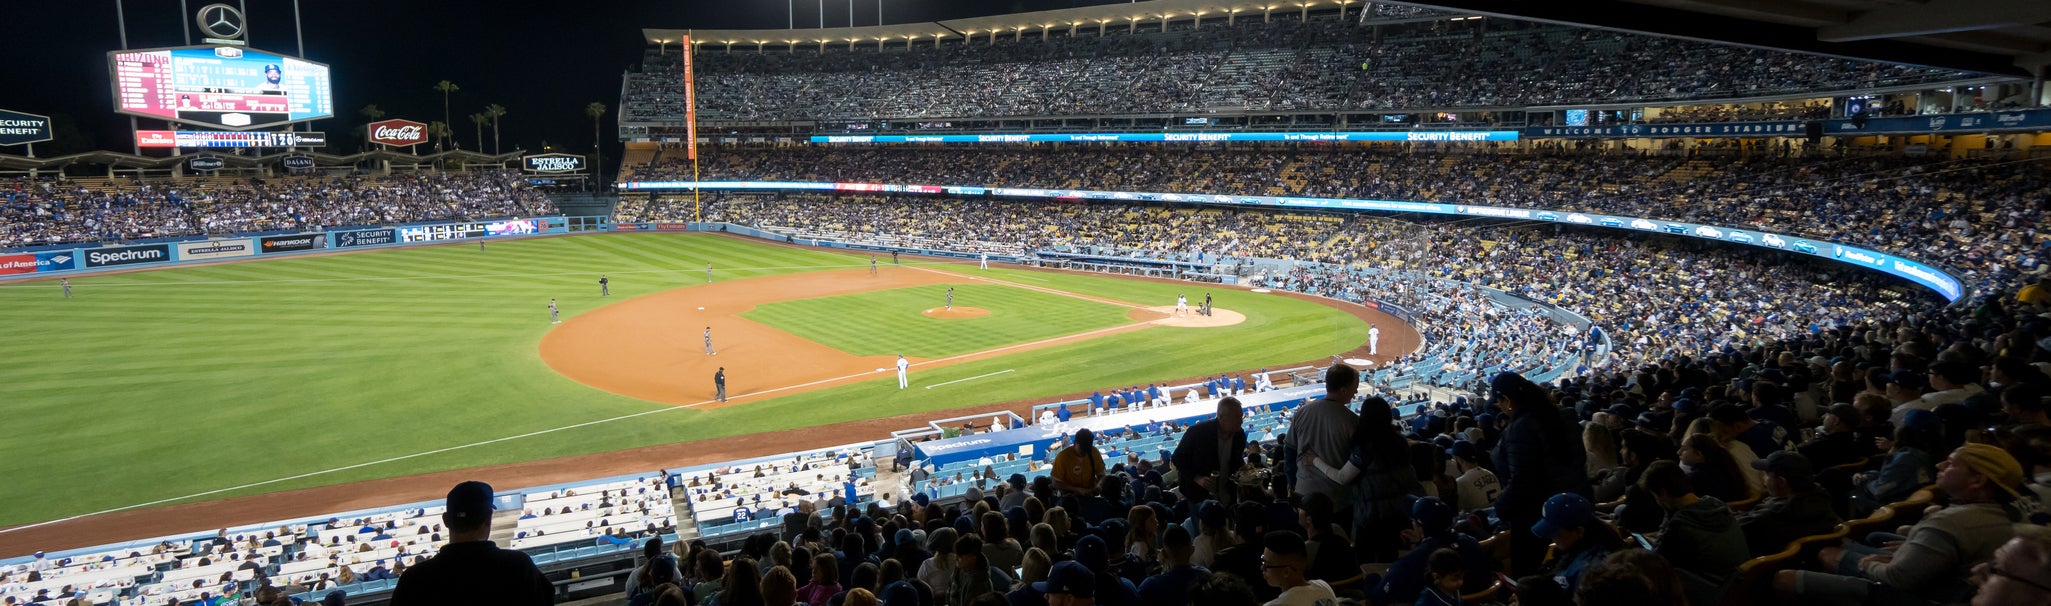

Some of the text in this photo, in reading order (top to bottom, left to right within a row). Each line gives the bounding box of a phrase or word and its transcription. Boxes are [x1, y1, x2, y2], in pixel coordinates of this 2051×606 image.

[0, 127, 39, 135] ENEFIT
[374, 125, 423, 140] Coca-Cola
[1650, 126, 1712, 134] DODGER
[1723, 124, 1796, 133] STADIUM
[279, 136, 286, 146] 2
[286, 136, 293, 146] 0
[1407, 132, 1448, 141] SECURITY
[531, 157, 579, 166] ESTRELLA
[537, 163, 575, 171] JALISCO
[356, 231, 392, 239] SECURITY
[90, 249, 161, 265] Spectrum
[13, 260, 50, 269] America
[927, 439, 986, 453] Spectrum
[737, 512, 746, 520] 22
